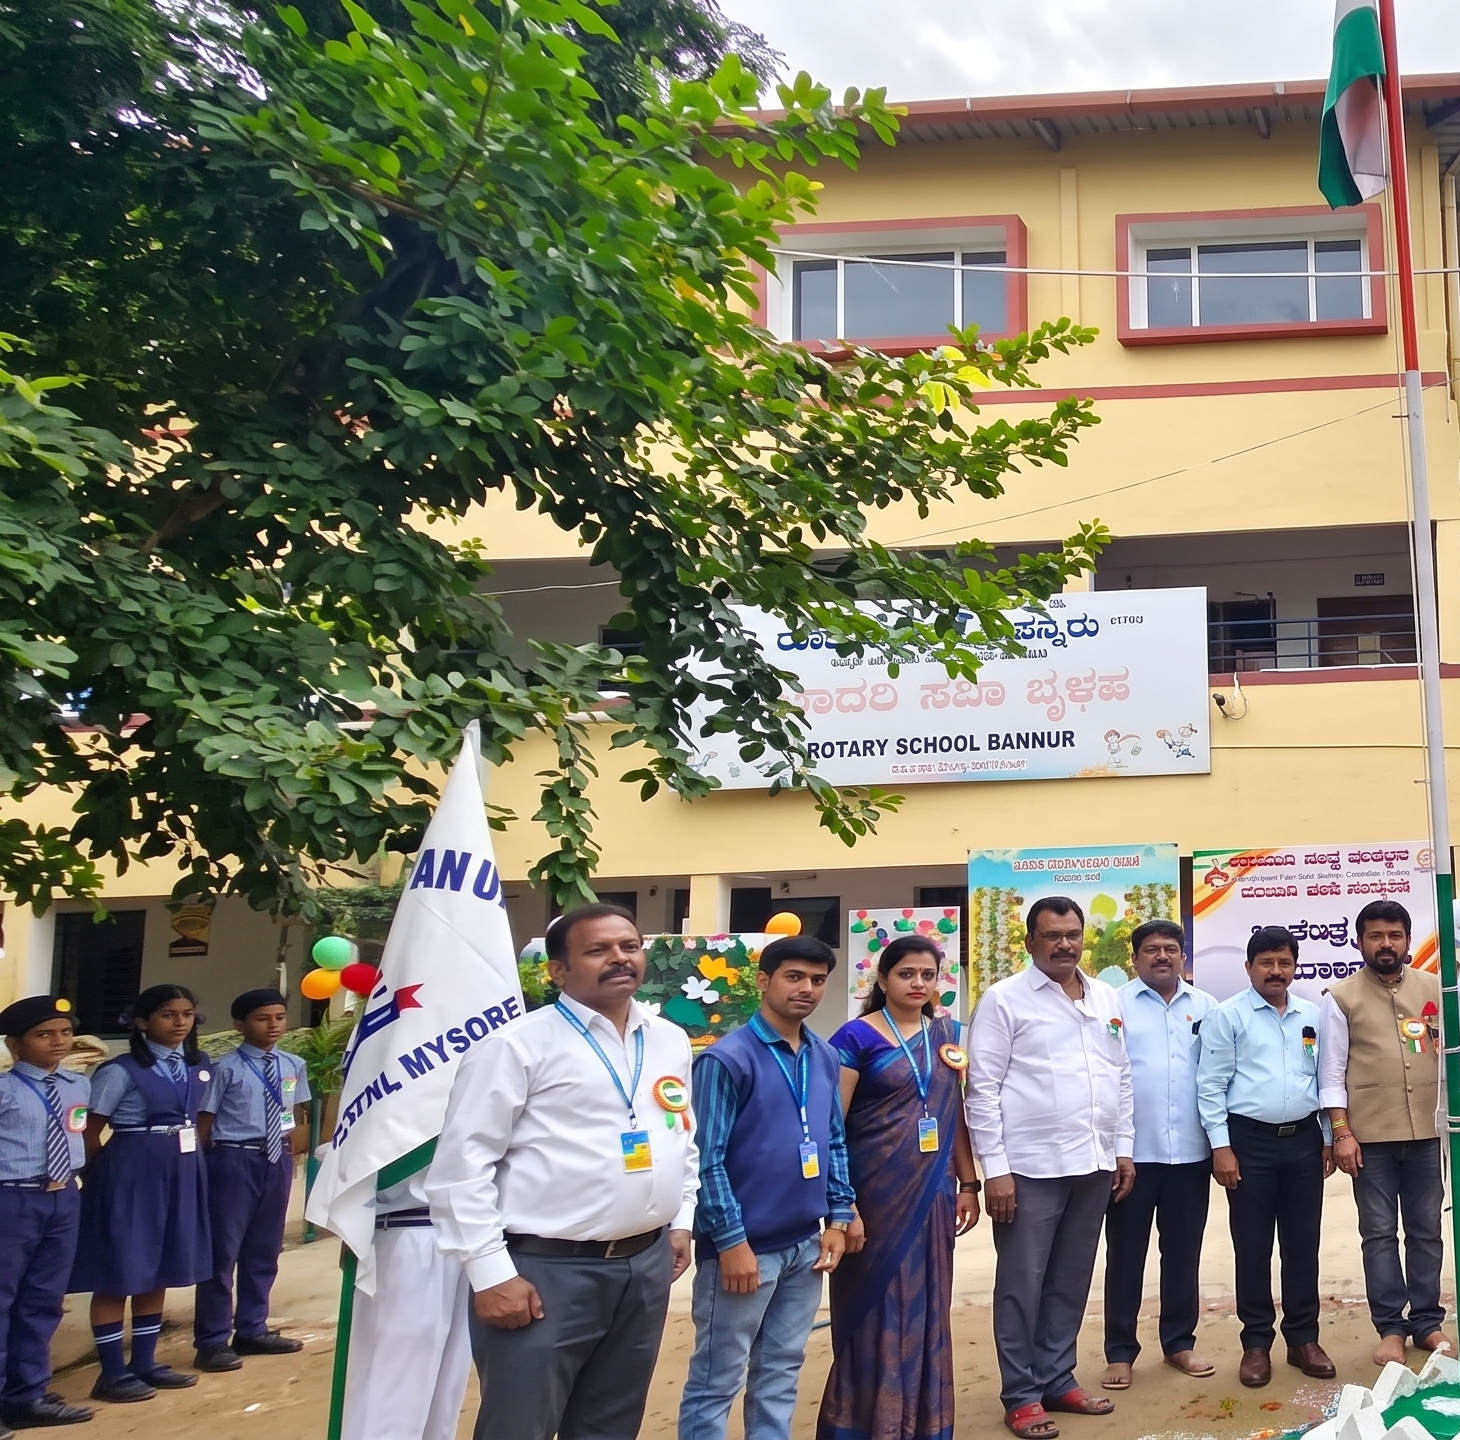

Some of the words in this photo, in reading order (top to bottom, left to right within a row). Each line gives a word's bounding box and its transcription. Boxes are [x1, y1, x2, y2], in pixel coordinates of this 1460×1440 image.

[807, 738, 889, 760] ROTARY
[896, 734, 981, 755] SCHOOL
[987, 730, 1076, 751] BANNUR
[473, 858, 507, 910] U
[398, 996, 522, 1080] MYSORE
